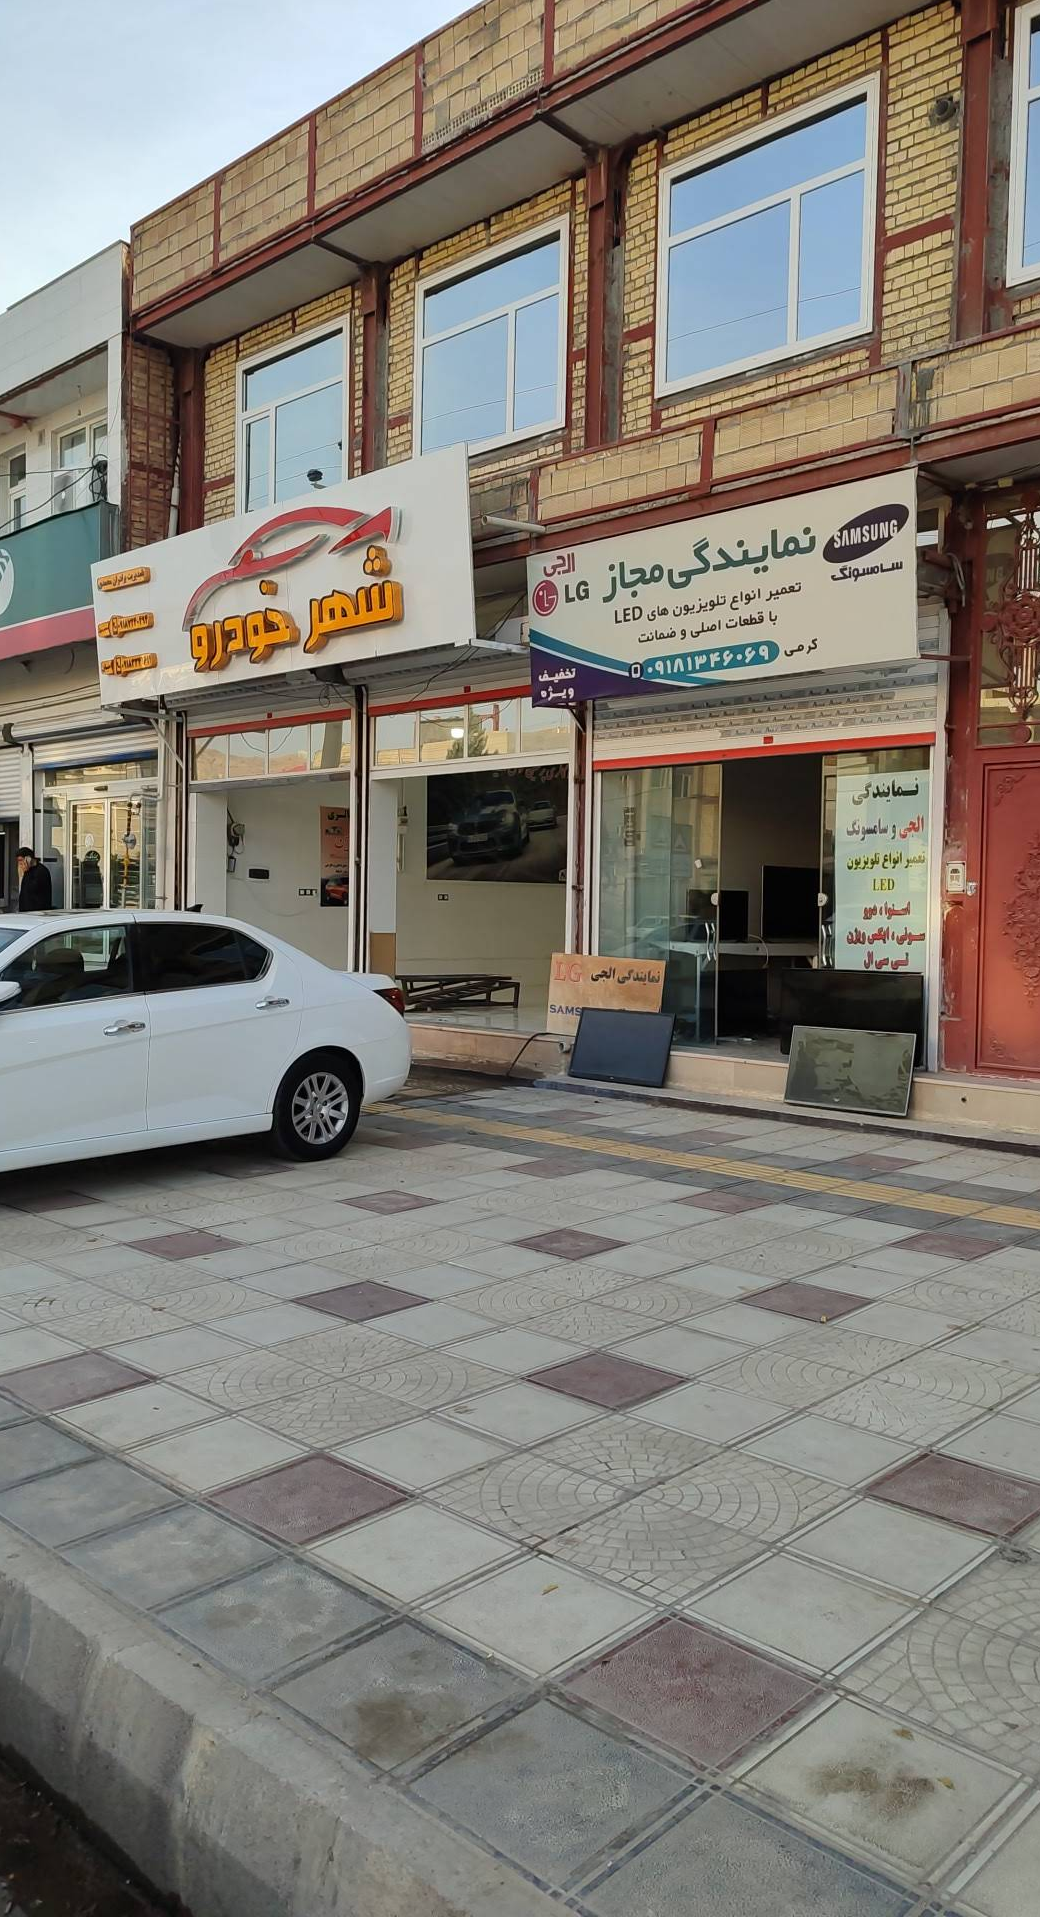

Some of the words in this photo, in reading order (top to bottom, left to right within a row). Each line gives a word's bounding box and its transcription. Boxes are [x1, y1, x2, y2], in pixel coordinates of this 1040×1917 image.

[833, 519, 898, 549] SAMSUNG
[543, 552, 576, 578] الجی
[667, 526, 817, 590] نمایندگی
[831, 560, 903, 582] سامسونگ
[564, 580, 590, 603] LG
[602, 561, 664, 604] مجاز
[303, 545, 403, 654] شهر
[729, 588, 761, 610] انواع
[765, 582, 802, 602] تعمیر
[647, 605, 669, 622] های
[673, 594, 726, 617] تلویزیون
[614, 606, 643, 624] LED
[725, 611, 765, 630] قطعات
[769, 611, 778, 625] با
[190, 579, 300, 673] خودرو
[638, 627, 677, 643] ضمانت
[680, 628, 687, 640] و
[690, 620, 722, 638] اصلی
[784, 638, 818, 657] کرمی
[538, 668, 576, 683] تخفیف
[540, 686, 575, 701] ویژه
[852, 777, 919, 806] نمایندگی
[891, 824, 897, 839] و
[899, 814, 925, 839] الجی
[846, 852, 880, 870] تلویزیون
[882, 851, 903, 869] انواع
[904, 851, 926, 868] تعمیر
[873, 878, 895, 891] LED
[554, 960, 582, 983] LG
[590, 966, 616, 982] الجی
[617, 968, 661, 986] نمایندگی
[549, 1004, 583, 1017] SAMS
